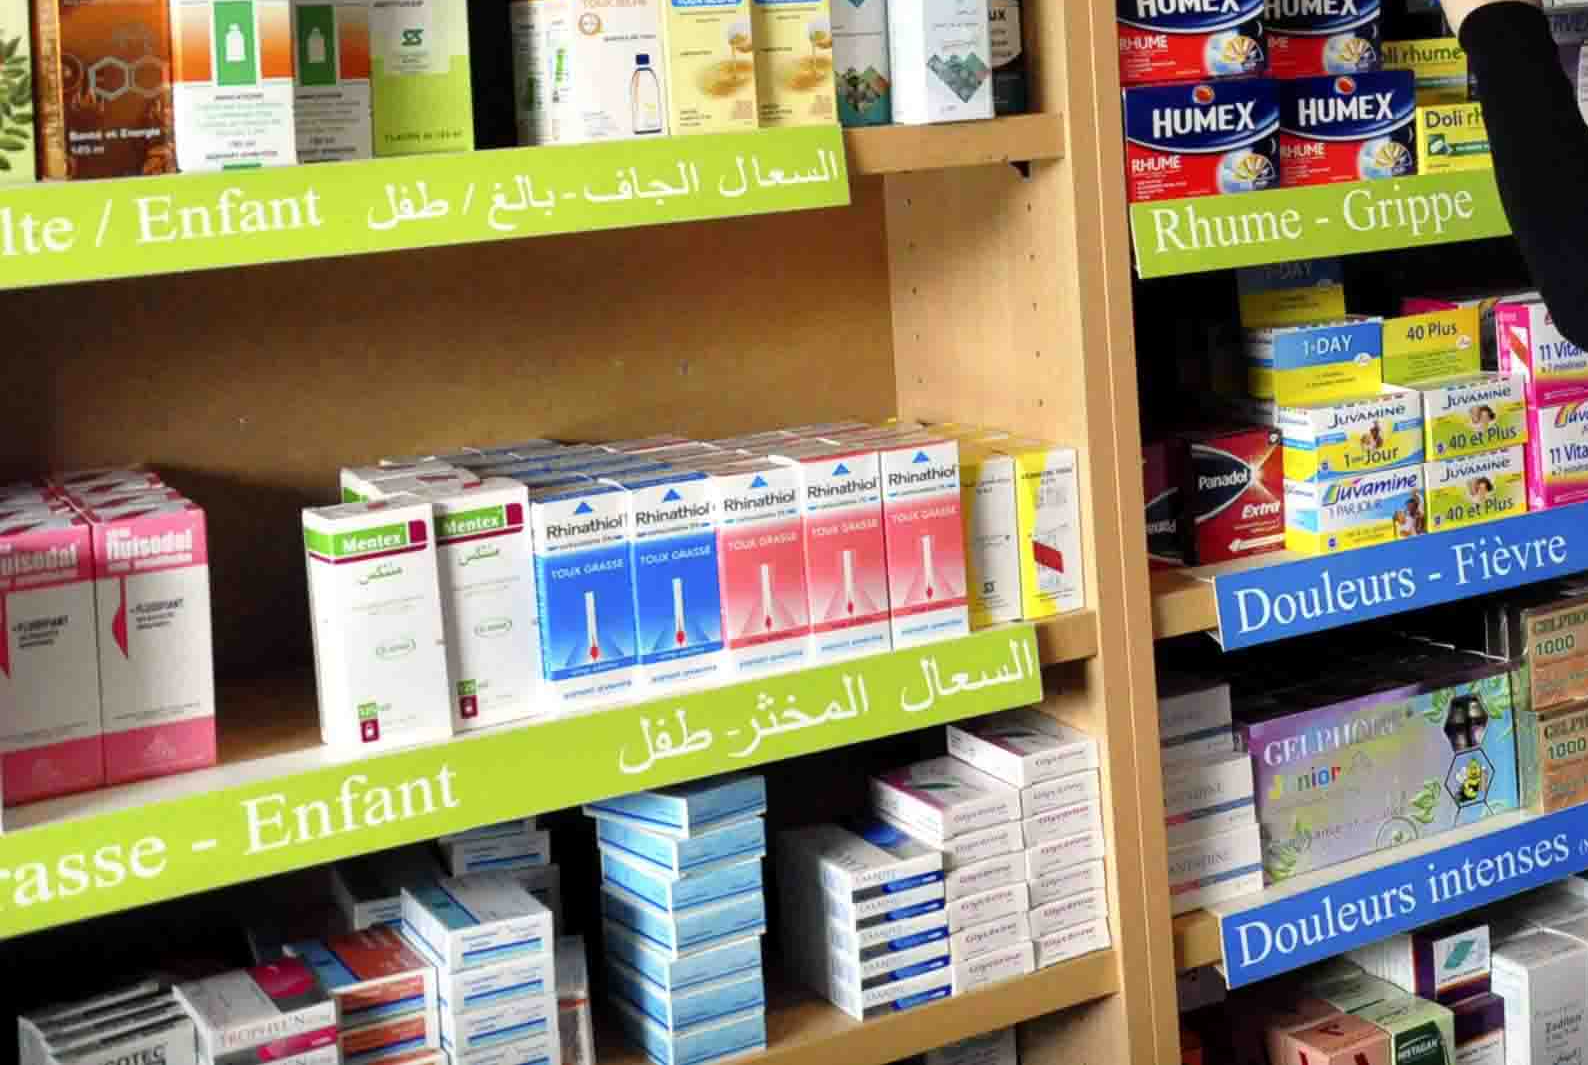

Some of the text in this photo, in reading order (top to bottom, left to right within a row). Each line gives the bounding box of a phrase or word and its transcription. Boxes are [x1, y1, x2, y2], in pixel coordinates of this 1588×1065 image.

[1119, 33, 1169, 50] RHUME
[1401, 43, 1462, 64] rhume
[1152, 101, 1257, 139] HUMEX
[1297, 92, 1394, 127] HUMEX
[1425, 110, 1464, 130] Doli
[1280, 142, 1326, 158] RHUME
[718, 148, 839, 199] السعال
[1130, 154, 1183, 173] RHUME
[367, 180, 451, 232] طفل
[0, 186, 326, 257] lte / Enfant
[1152, 203, 1303, 255] Rhume
[1342, 182, 1474, 237] Grippe
[1406, 322, 1459, 342] 40 Plus
[1303, 334, 1353, 357] 1-DAY
[1539, 343, 1551, 359] 11
[1446, 387, 1513, 410] JUVAMINE
[1327, 404, 1407, 429] JUVAMINE
[1449, 423, 1517, 451] 40 et Plus
[1550, 448, 1561, 464] 11
[887, 459, 957, 487] Rhinathiol
[1198, 466, 1249, 491] Panadol
[1440, 457, 1512, 482] JUVAMINE
[806, 473, 879, 501] Rhinathiol
[723, 487, 797, 514] Rhinathiol
[1242, 500, 1281, 520] Extra
[1446, 495, 1515, 522] 40 et Plus
[635, 499, 710, 528] Rhinathiol
[889, 504, 957, 525] TOUX GRASSE
[445, 517, 499, 536] Mentex
[546, 513, 623, 541] Rhinathiol
[811, 516, 880, 538] TOUX GRASSE
[343, 532, 401, 553] Mentex
[727, 531, 799, 553] TOUX GRASSE
[639, 544, 711, 566] TOUX GRASSE
[550, 556, 625, 580] TOUX GRASSE
[1232, 565, 1417, 634] Douleurs
[1451, 534, 1568, 587] Fièvre
[1534, 634, 1576, 656] 1000
[900, 637, 1037, 713] السعال
[1546, 737, 1588, 760] 1000
[240, 764, 461, 858] Enfant
[1235, 880, 1418, 970] Douleurs
[1426, 829, 1570, 905] intenses
